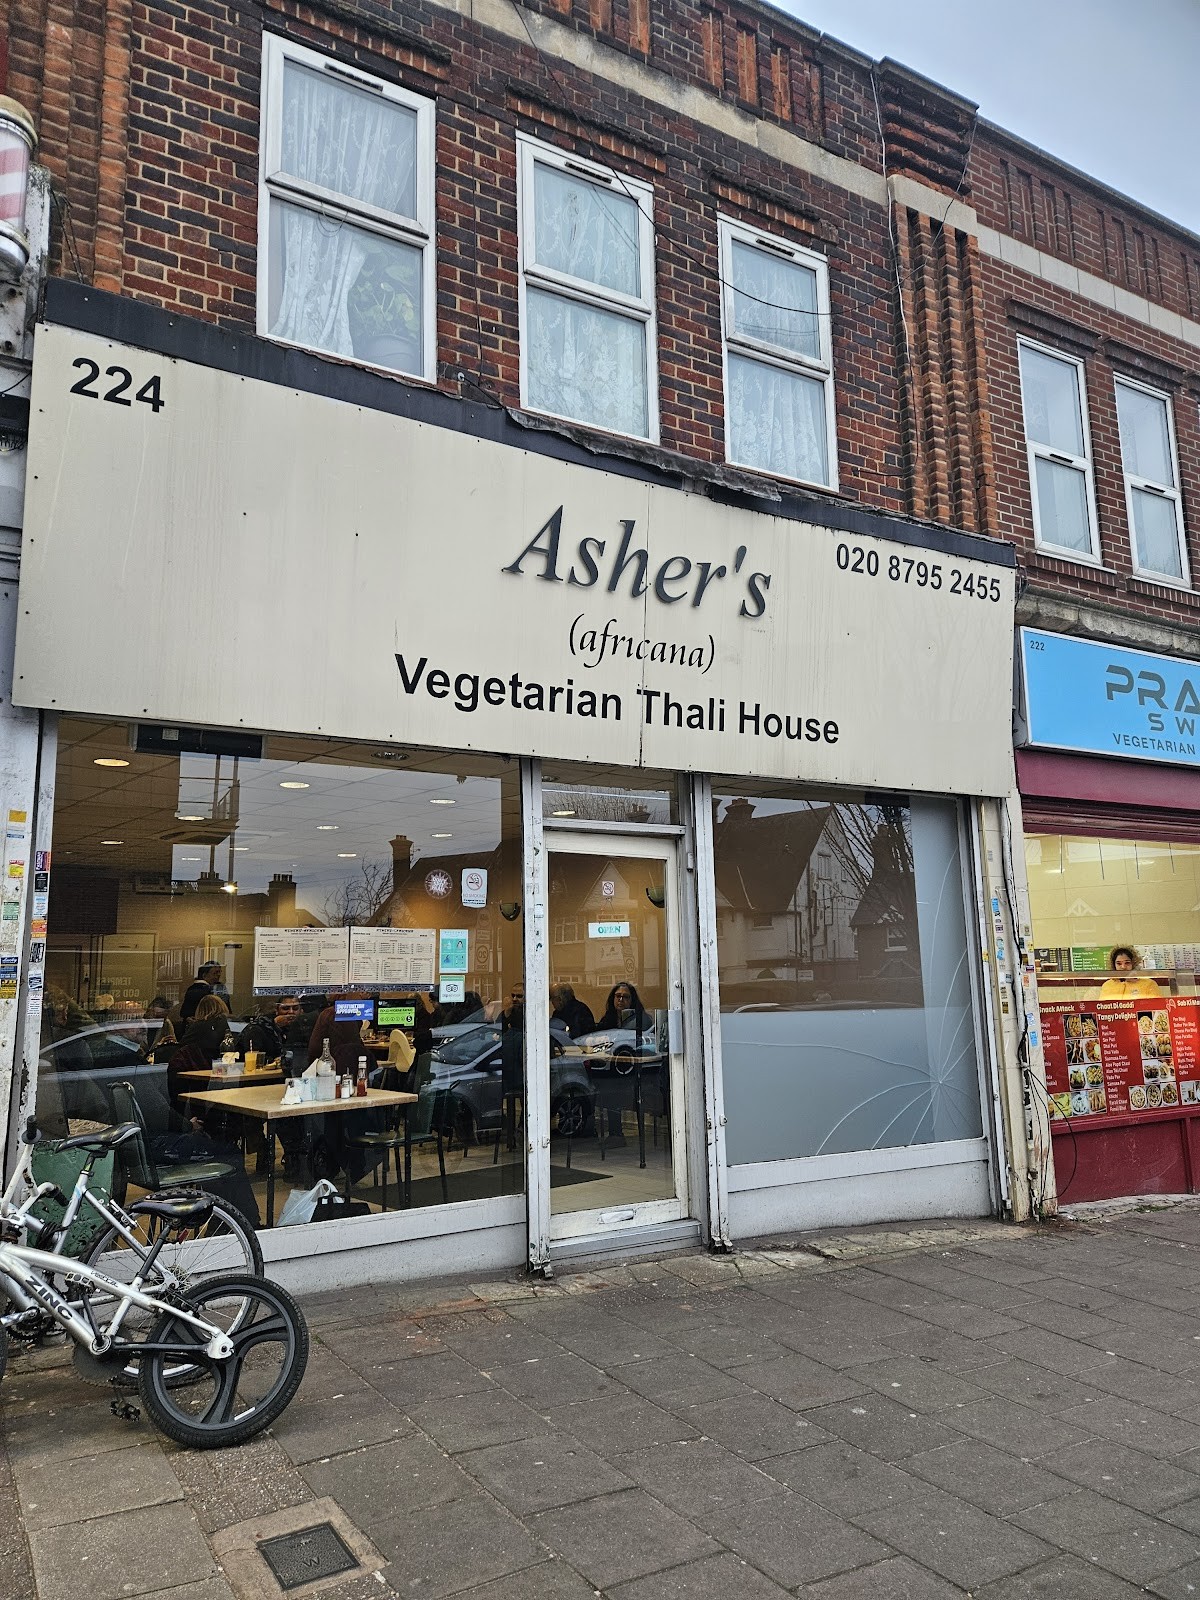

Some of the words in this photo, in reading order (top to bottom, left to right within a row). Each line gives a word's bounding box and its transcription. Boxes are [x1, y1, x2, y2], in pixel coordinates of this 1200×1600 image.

[70, 357, 165, 413] 224
[501, 505, 772, 619] Asher's
[836, 543, 879, 577] 020
[888, 554, 943, 590] 8795
[950, 569, 1001, 603] 2455
[569, 613, 715, 674] (africana)
[1030, 640, 1045, 651] 222
[395, 653, 622, 721] Vegetarian
[636, 688, 725, 732] Thali
[739, 701, 839, 744] House
[1113, 732, 1196, 755] VEGETARIAN
[597, 925, 621, 934] OPEN
[1098, 1013, 1114, 1021] Tangy
[1115, 1011, 1136, 1021] Delights
[25, 1276, 73, 1320] ZINC
[302, 1556, 321, 1568] W
